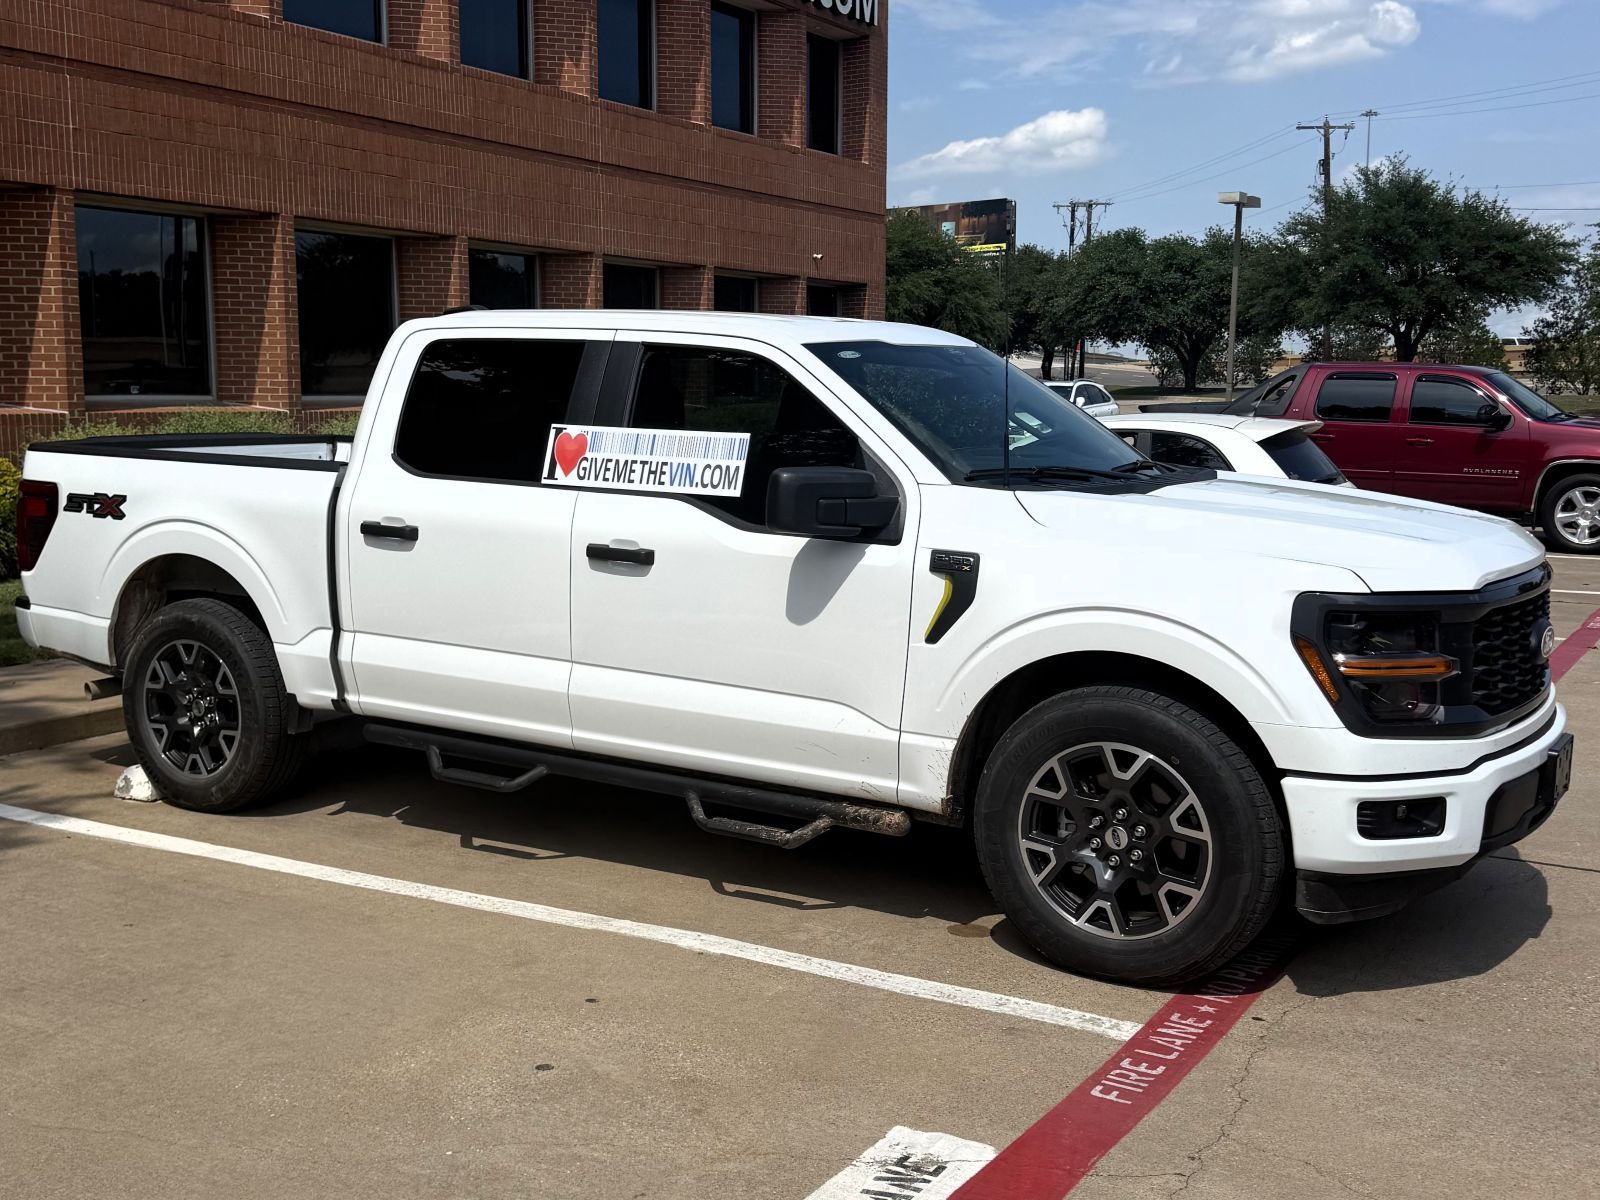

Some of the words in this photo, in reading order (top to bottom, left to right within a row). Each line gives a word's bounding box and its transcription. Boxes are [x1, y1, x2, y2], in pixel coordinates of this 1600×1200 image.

[576, 456, 740, 491] GIVEMETHEVIN.COM
[63, 492, 128, 520] STX
[1090, 1057, 1167, 1105] FIRE
[1135, 1012, 1214, 1061] LANE
